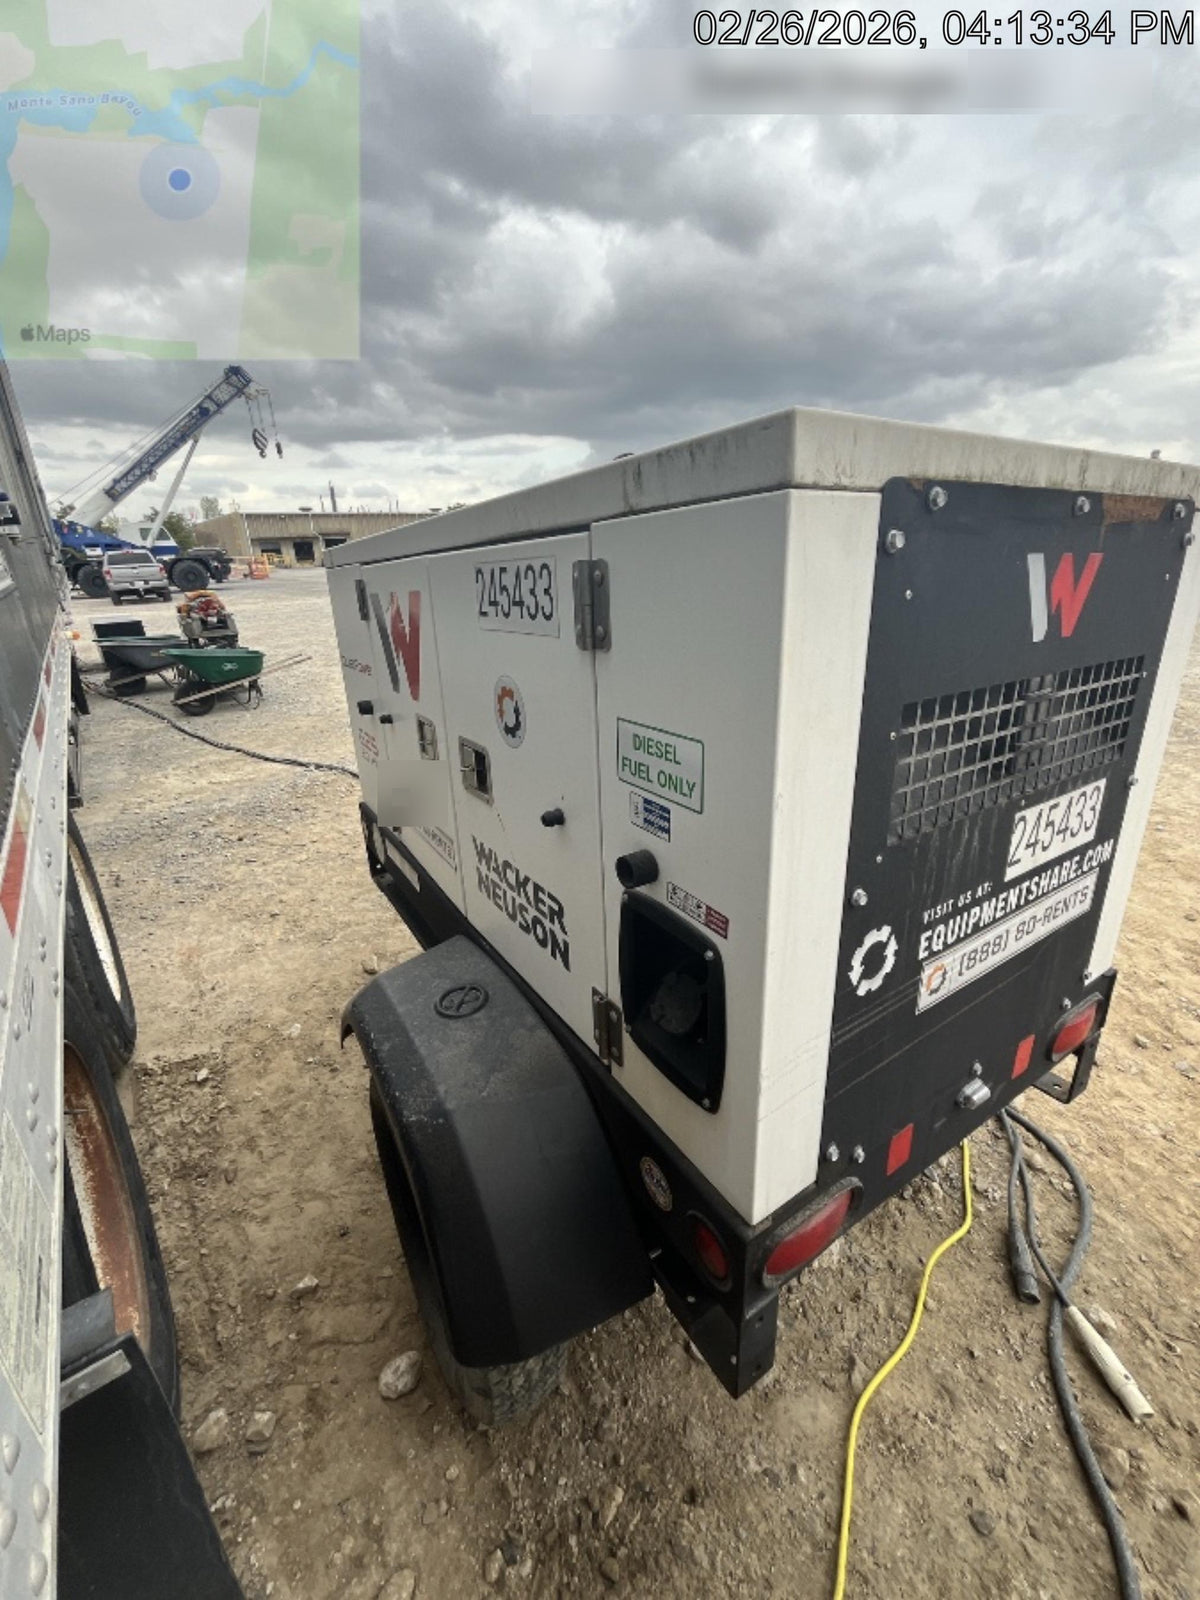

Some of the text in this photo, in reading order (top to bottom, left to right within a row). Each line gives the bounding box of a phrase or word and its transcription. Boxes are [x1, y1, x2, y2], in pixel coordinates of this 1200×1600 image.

[475, 563, 554, 621] 245433
[621, 756, 696, 799] FUEL ONLY
[632, 733, 681, 765] DIESEL
[1007, 785, 1101, 868] 245433
[471, 834, 568, 936] WACKER
[476, 866, 571, 973] NEUSON
[919, 839, 1114, 960] EQUIPMENTSHARE.COM
[923, 899, 954, 925] VISIT
[957, 891, 975, 909] US
[958, 885, 1089, 977] (888) 80-RENTS
